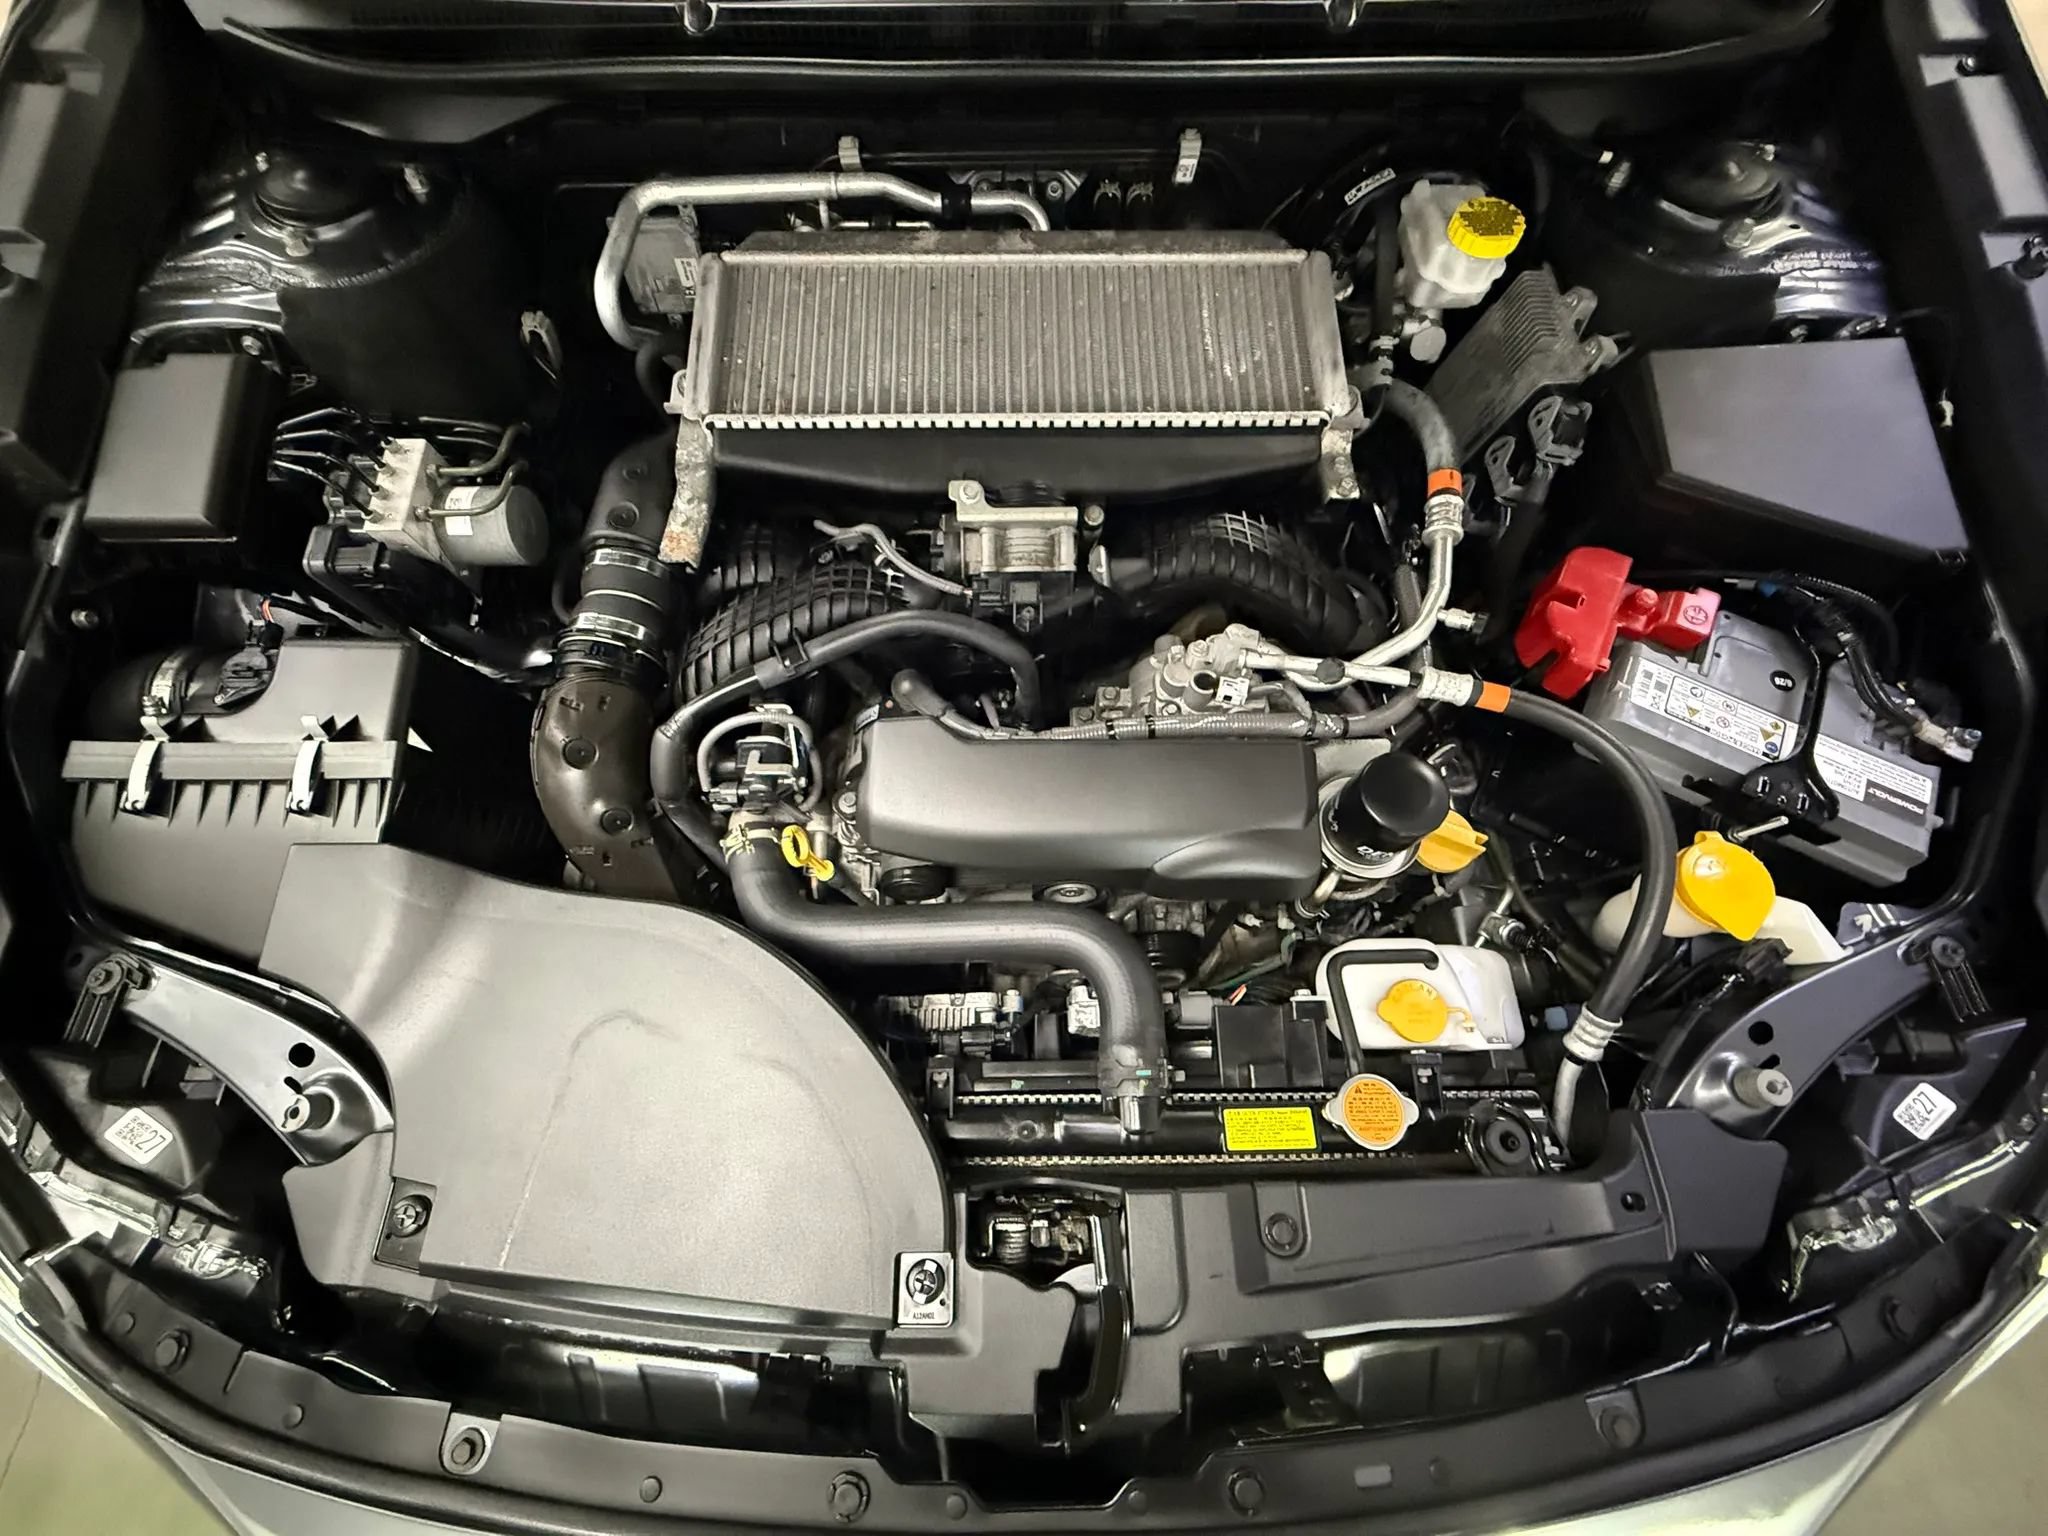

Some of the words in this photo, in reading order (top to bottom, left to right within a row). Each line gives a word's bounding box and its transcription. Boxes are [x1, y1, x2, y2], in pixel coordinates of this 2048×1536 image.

[1867, 787, 1924, 815] POWERVOLT
[1912, 1091, 1937, 1115] 27
[135, 1129, 166, 1154] 27
